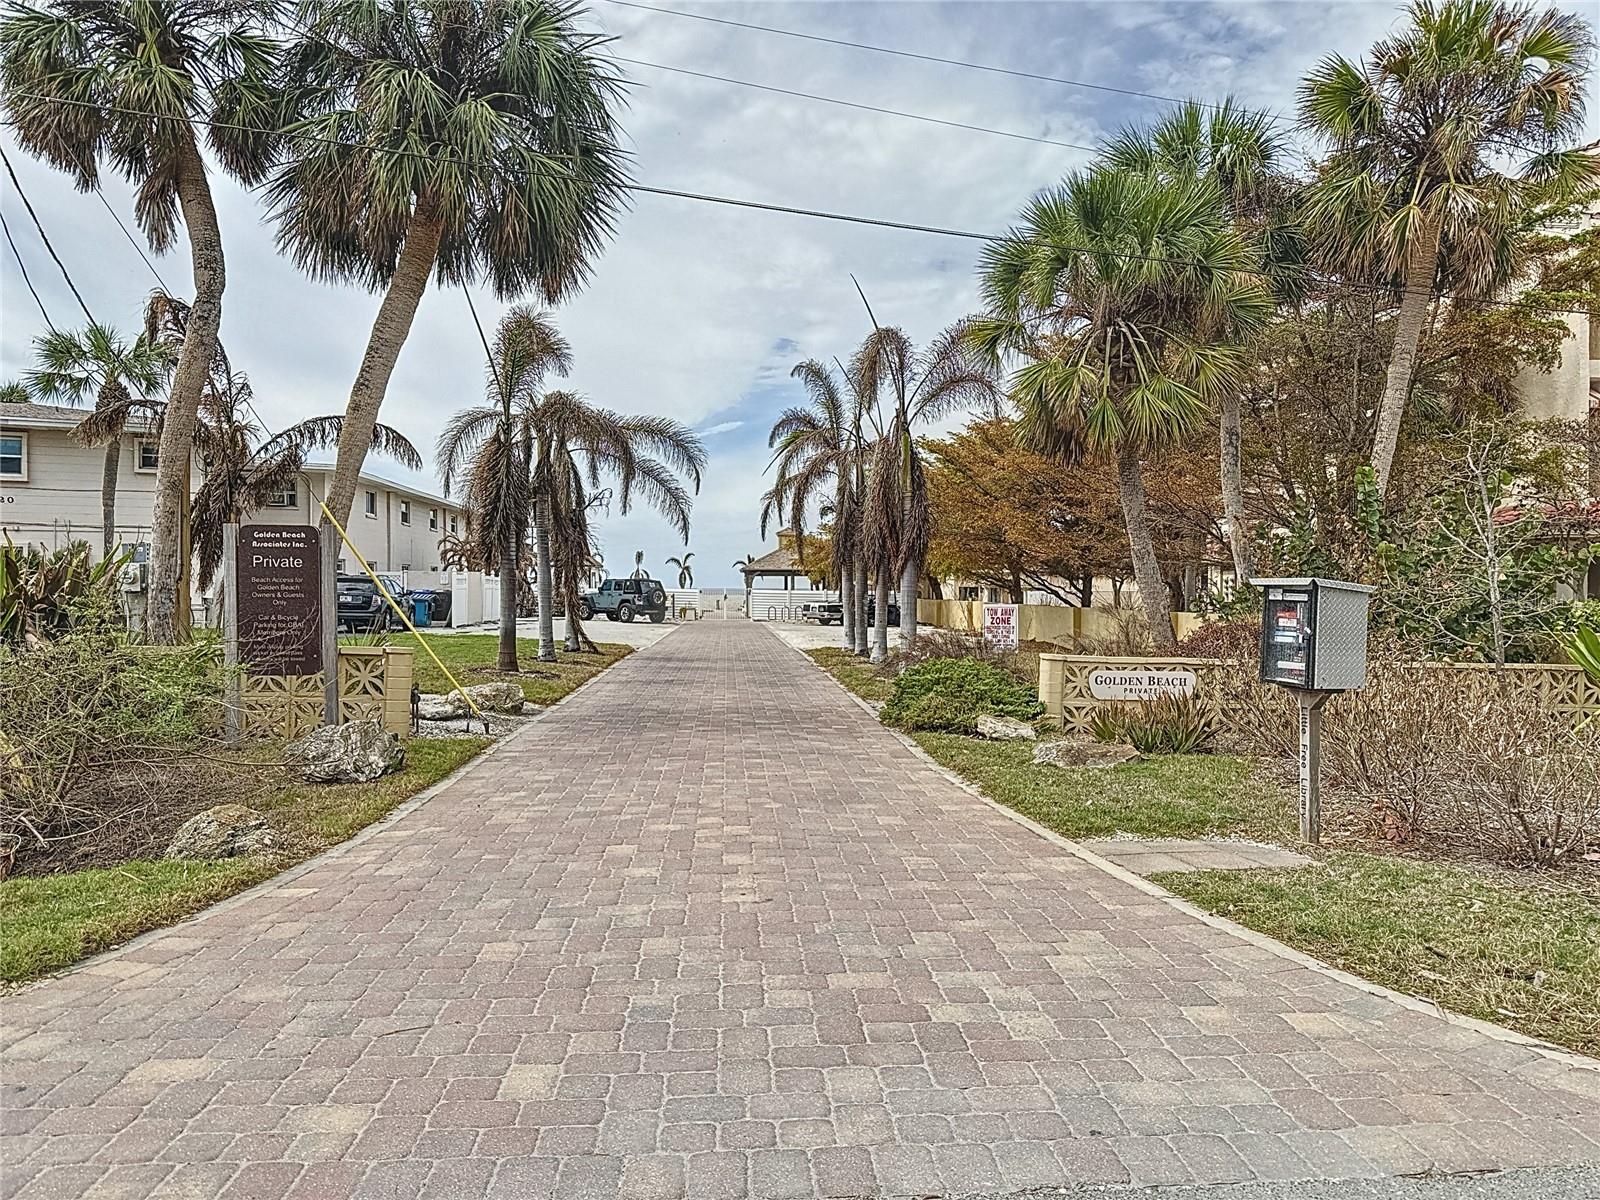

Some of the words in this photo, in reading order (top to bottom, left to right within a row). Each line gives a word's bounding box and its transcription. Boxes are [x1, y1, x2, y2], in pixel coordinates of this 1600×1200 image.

[252, 555, 303, 568] Private
[987, 608, 998, 616] TOW
[1001, 608, 1014, 616] AWAY
[990, 617, 1012, 625] ZONE
[1094, 675, 1143, 686] GOLDEN
[1148, 675, 1187, 687] BEACH
[1300, 706, 1309, 735] Little
[1300, 743, 1309, 769] Free
[1300, 777, 1309, 820] Library
